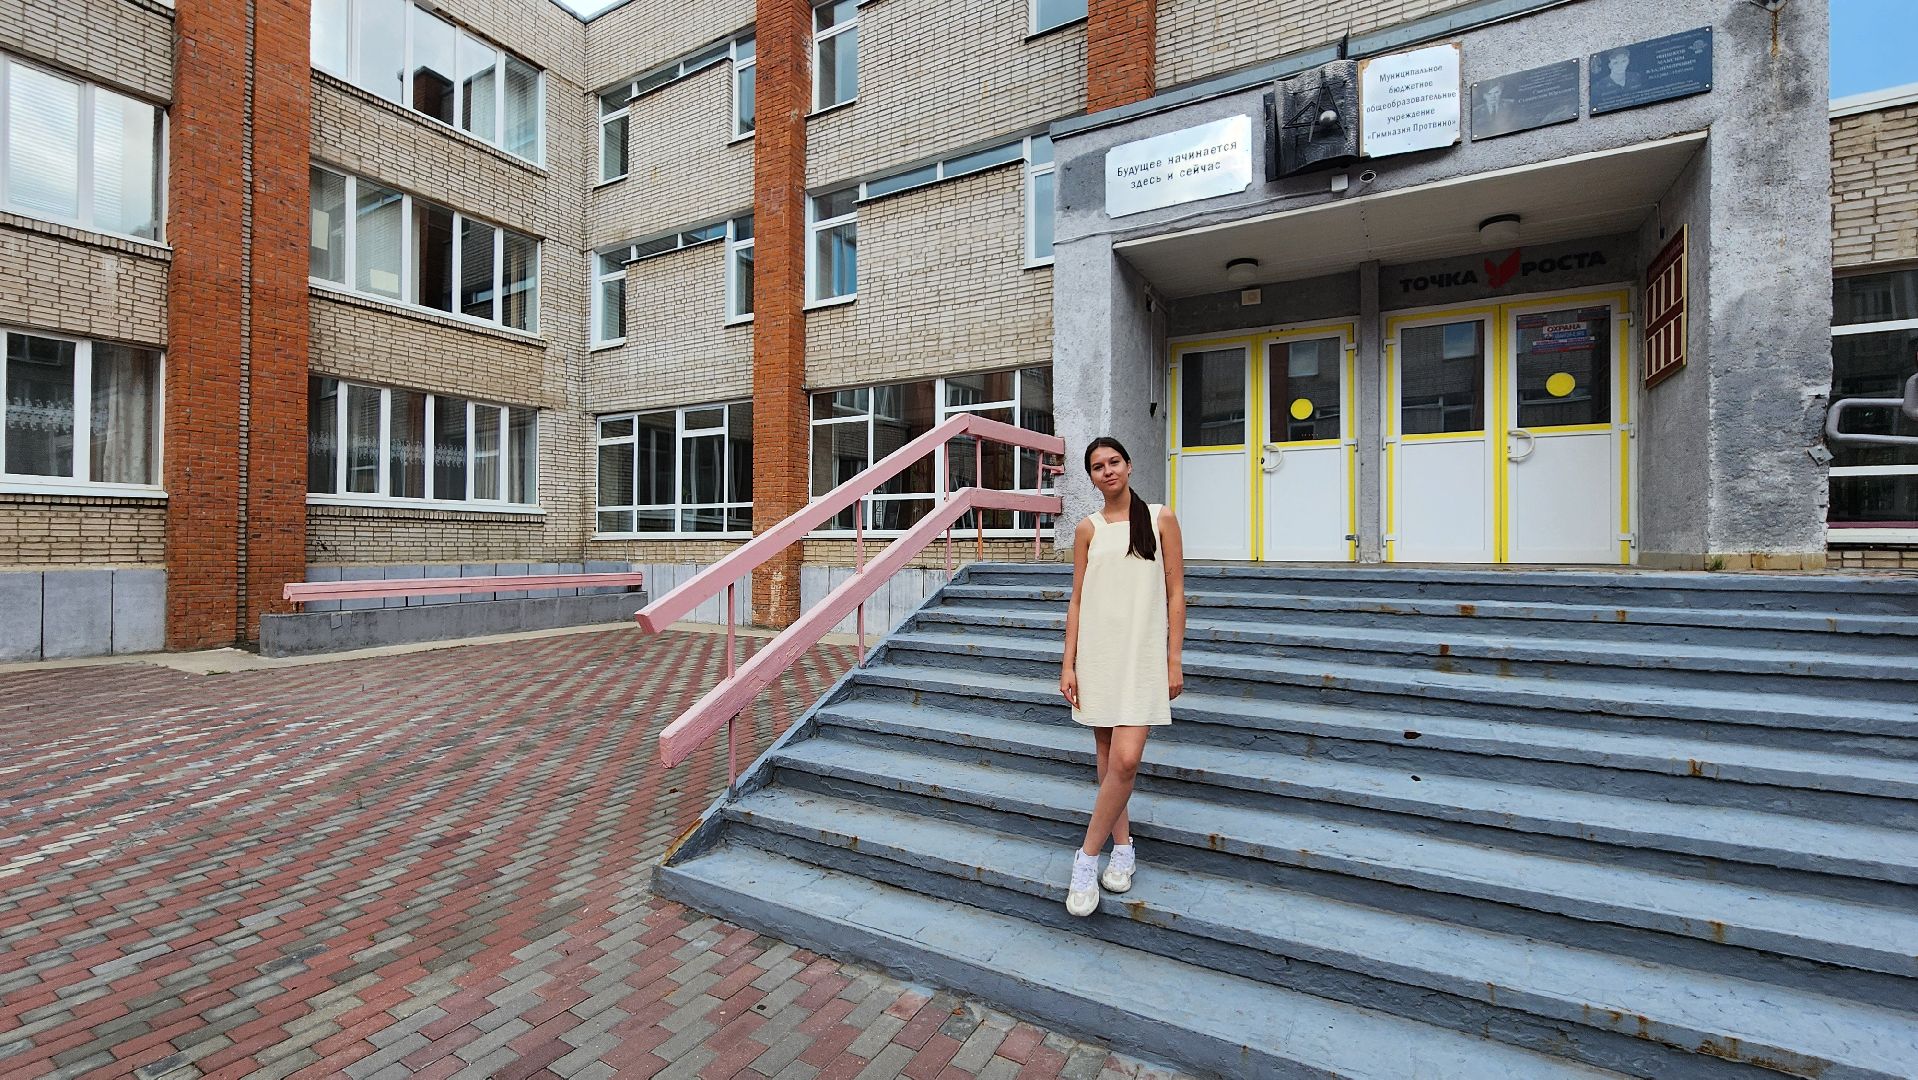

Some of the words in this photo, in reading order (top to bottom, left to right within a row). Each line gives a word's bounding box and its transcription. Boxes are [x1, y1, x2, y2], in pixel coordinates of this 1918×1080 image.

[1379, 65, 1443, 82] Муниципальное
[1388, 81, 1434, 94] бюджетное
[1387, 108, 1436, 124] учреждение
[1367, 126, 1411, 140] «Гимназия
[1412, 119, 1456, 132] Протвино»
[1117, 159, 1162, 178] Будущее
[1168, 141, 1237, 165] начинается
[1131, 176, 1162, 189] здесь
[1167, 172, 1174, 181] и
[1179, 161, 1221, 178] сейчас
[1400, 270, 1478, 293] ТОЧКА
[1521, 250, 1607, 277] РОСТА
[1547, 322, 1581, 333] ОХРАНА
